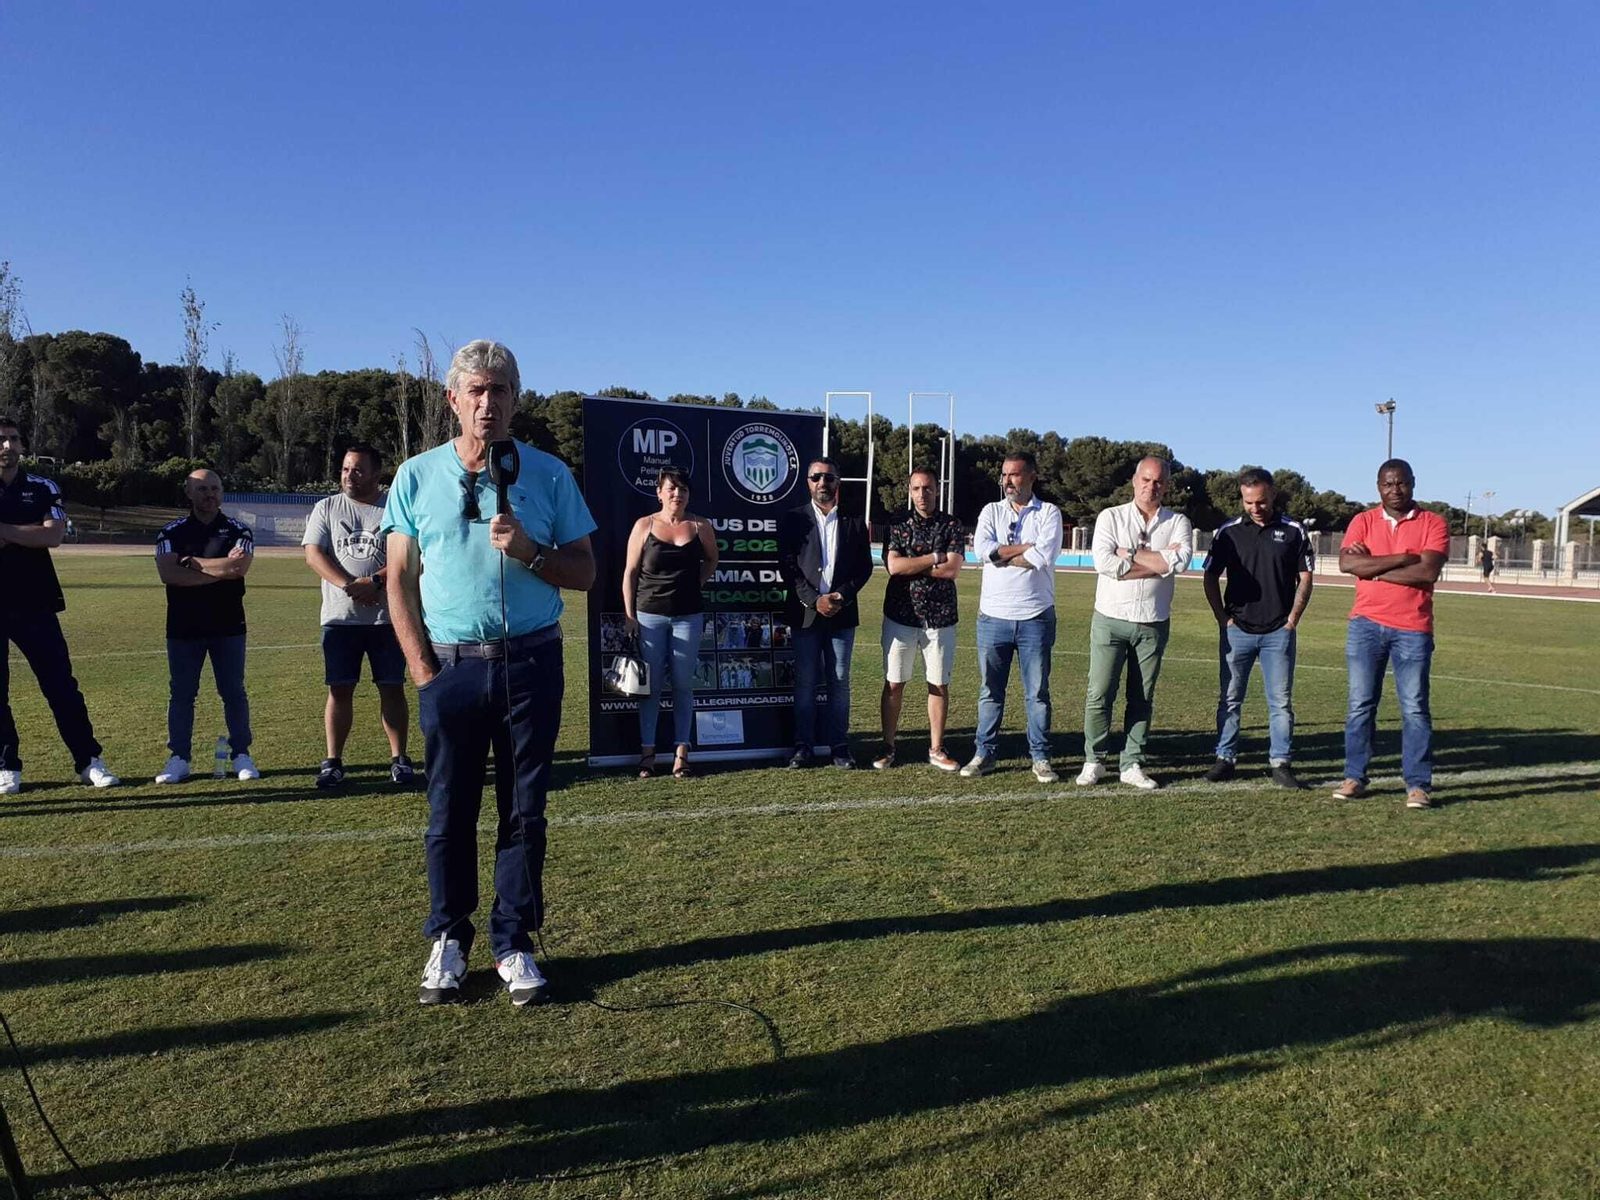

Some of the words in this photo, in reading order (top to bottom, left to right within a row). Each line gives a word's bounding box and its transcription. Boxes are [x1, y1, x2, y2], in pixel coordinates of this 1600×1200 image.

[724, 431, 745, 467] JUVENTUD
[744, 425, 794, 456] TORREMOLINOS
[643, 455, 672, 465] Manuel
[640, 466, 661, 475] Pelle
[751, 494, 775, 502] 1958
[747, 519, 777, 532] DE
[336, 537, 387, 552] BASEBALL
